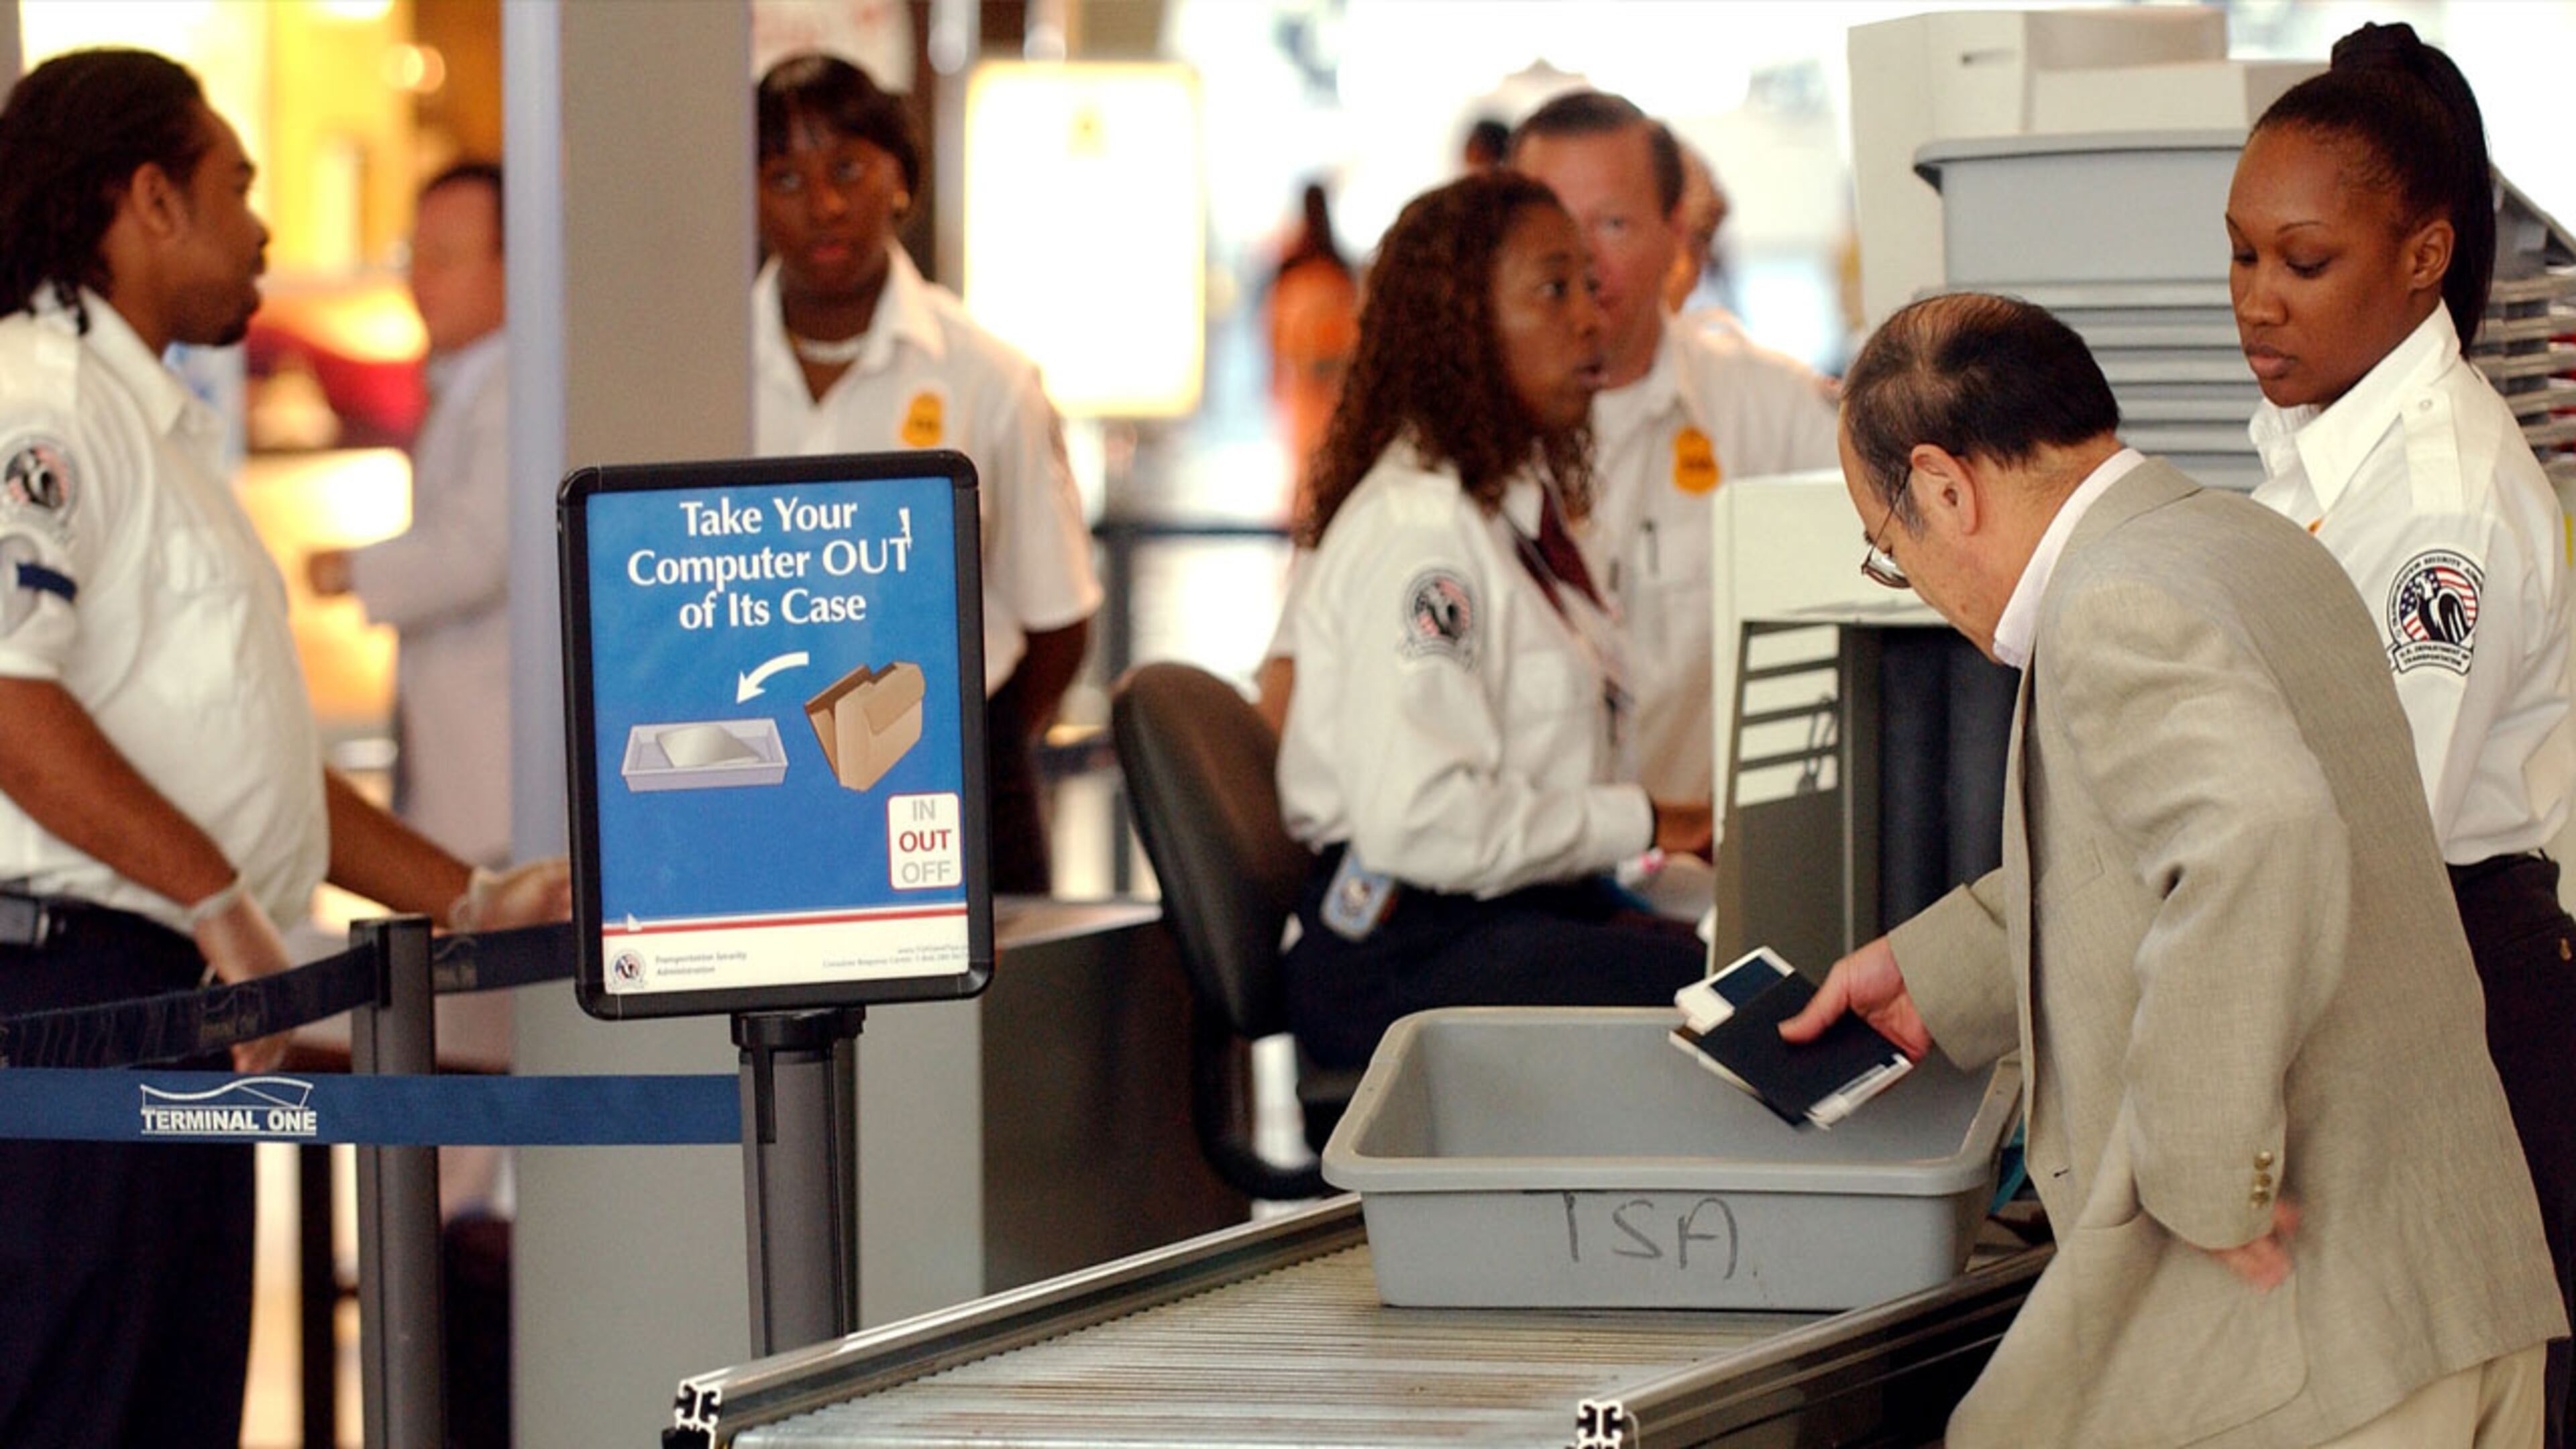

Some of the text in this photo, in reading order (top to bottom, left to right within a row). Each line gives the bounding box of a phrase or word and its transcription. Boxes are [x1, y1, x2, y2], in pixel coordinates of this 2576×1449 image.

[680, 496, 858, 537] Take Your
[627, 537, 912, 592] Computer OUT
[680, 588, 866, 629] of Its Case
[912, 798, 936, 822] IN
[899, 828, 952, 853] OUT
[901, 860, 951, 884] OFF
[141, 1108, 317, 1131] TERMINAL ONE
[1523, 1189, 1738, 1280] TSA
